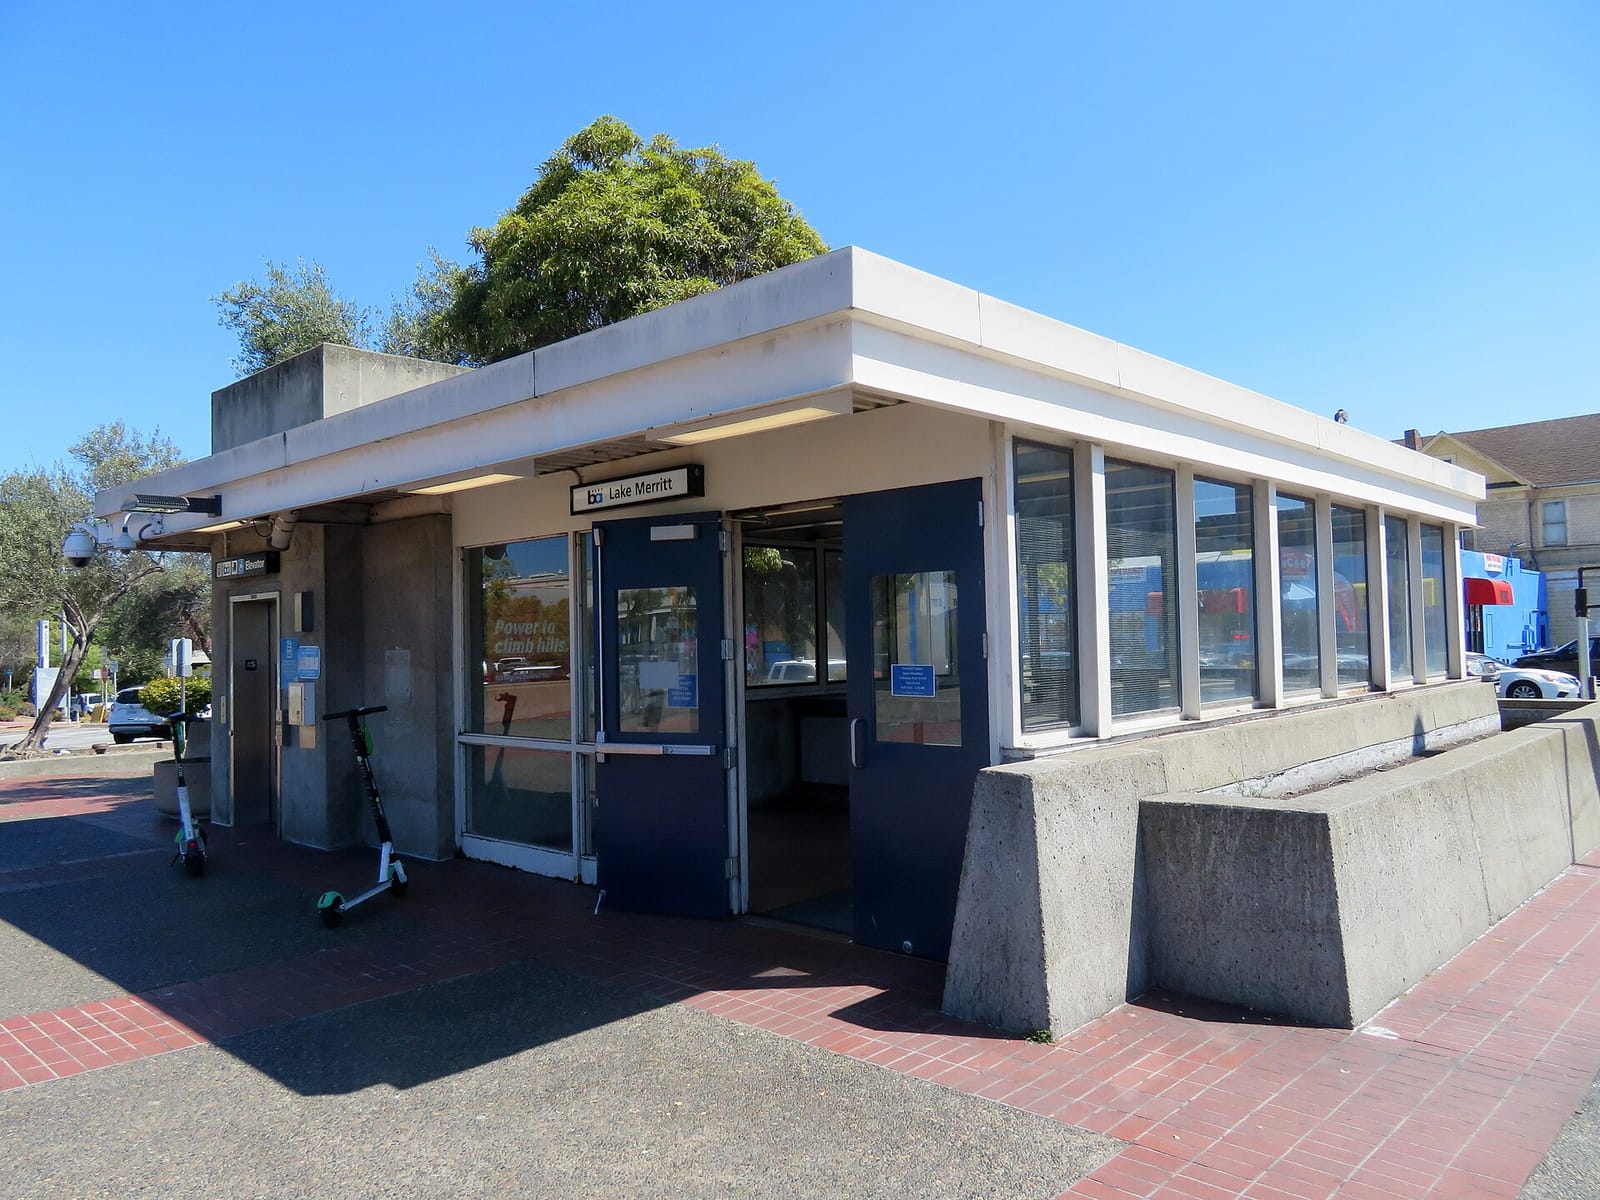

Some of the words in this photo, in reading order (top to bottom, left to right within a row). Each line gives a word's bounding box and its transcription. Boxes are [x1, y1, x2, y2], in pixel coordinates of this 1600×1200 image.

[610, 484, 632, 500] Lake
[635, 477, 673, 496] Merritt
[245, 559, 265, 570] Elevator
[494, 619, 538, 635] Power
[542, 619, 557, 634] to
[494, 636, 535, 654] climb
